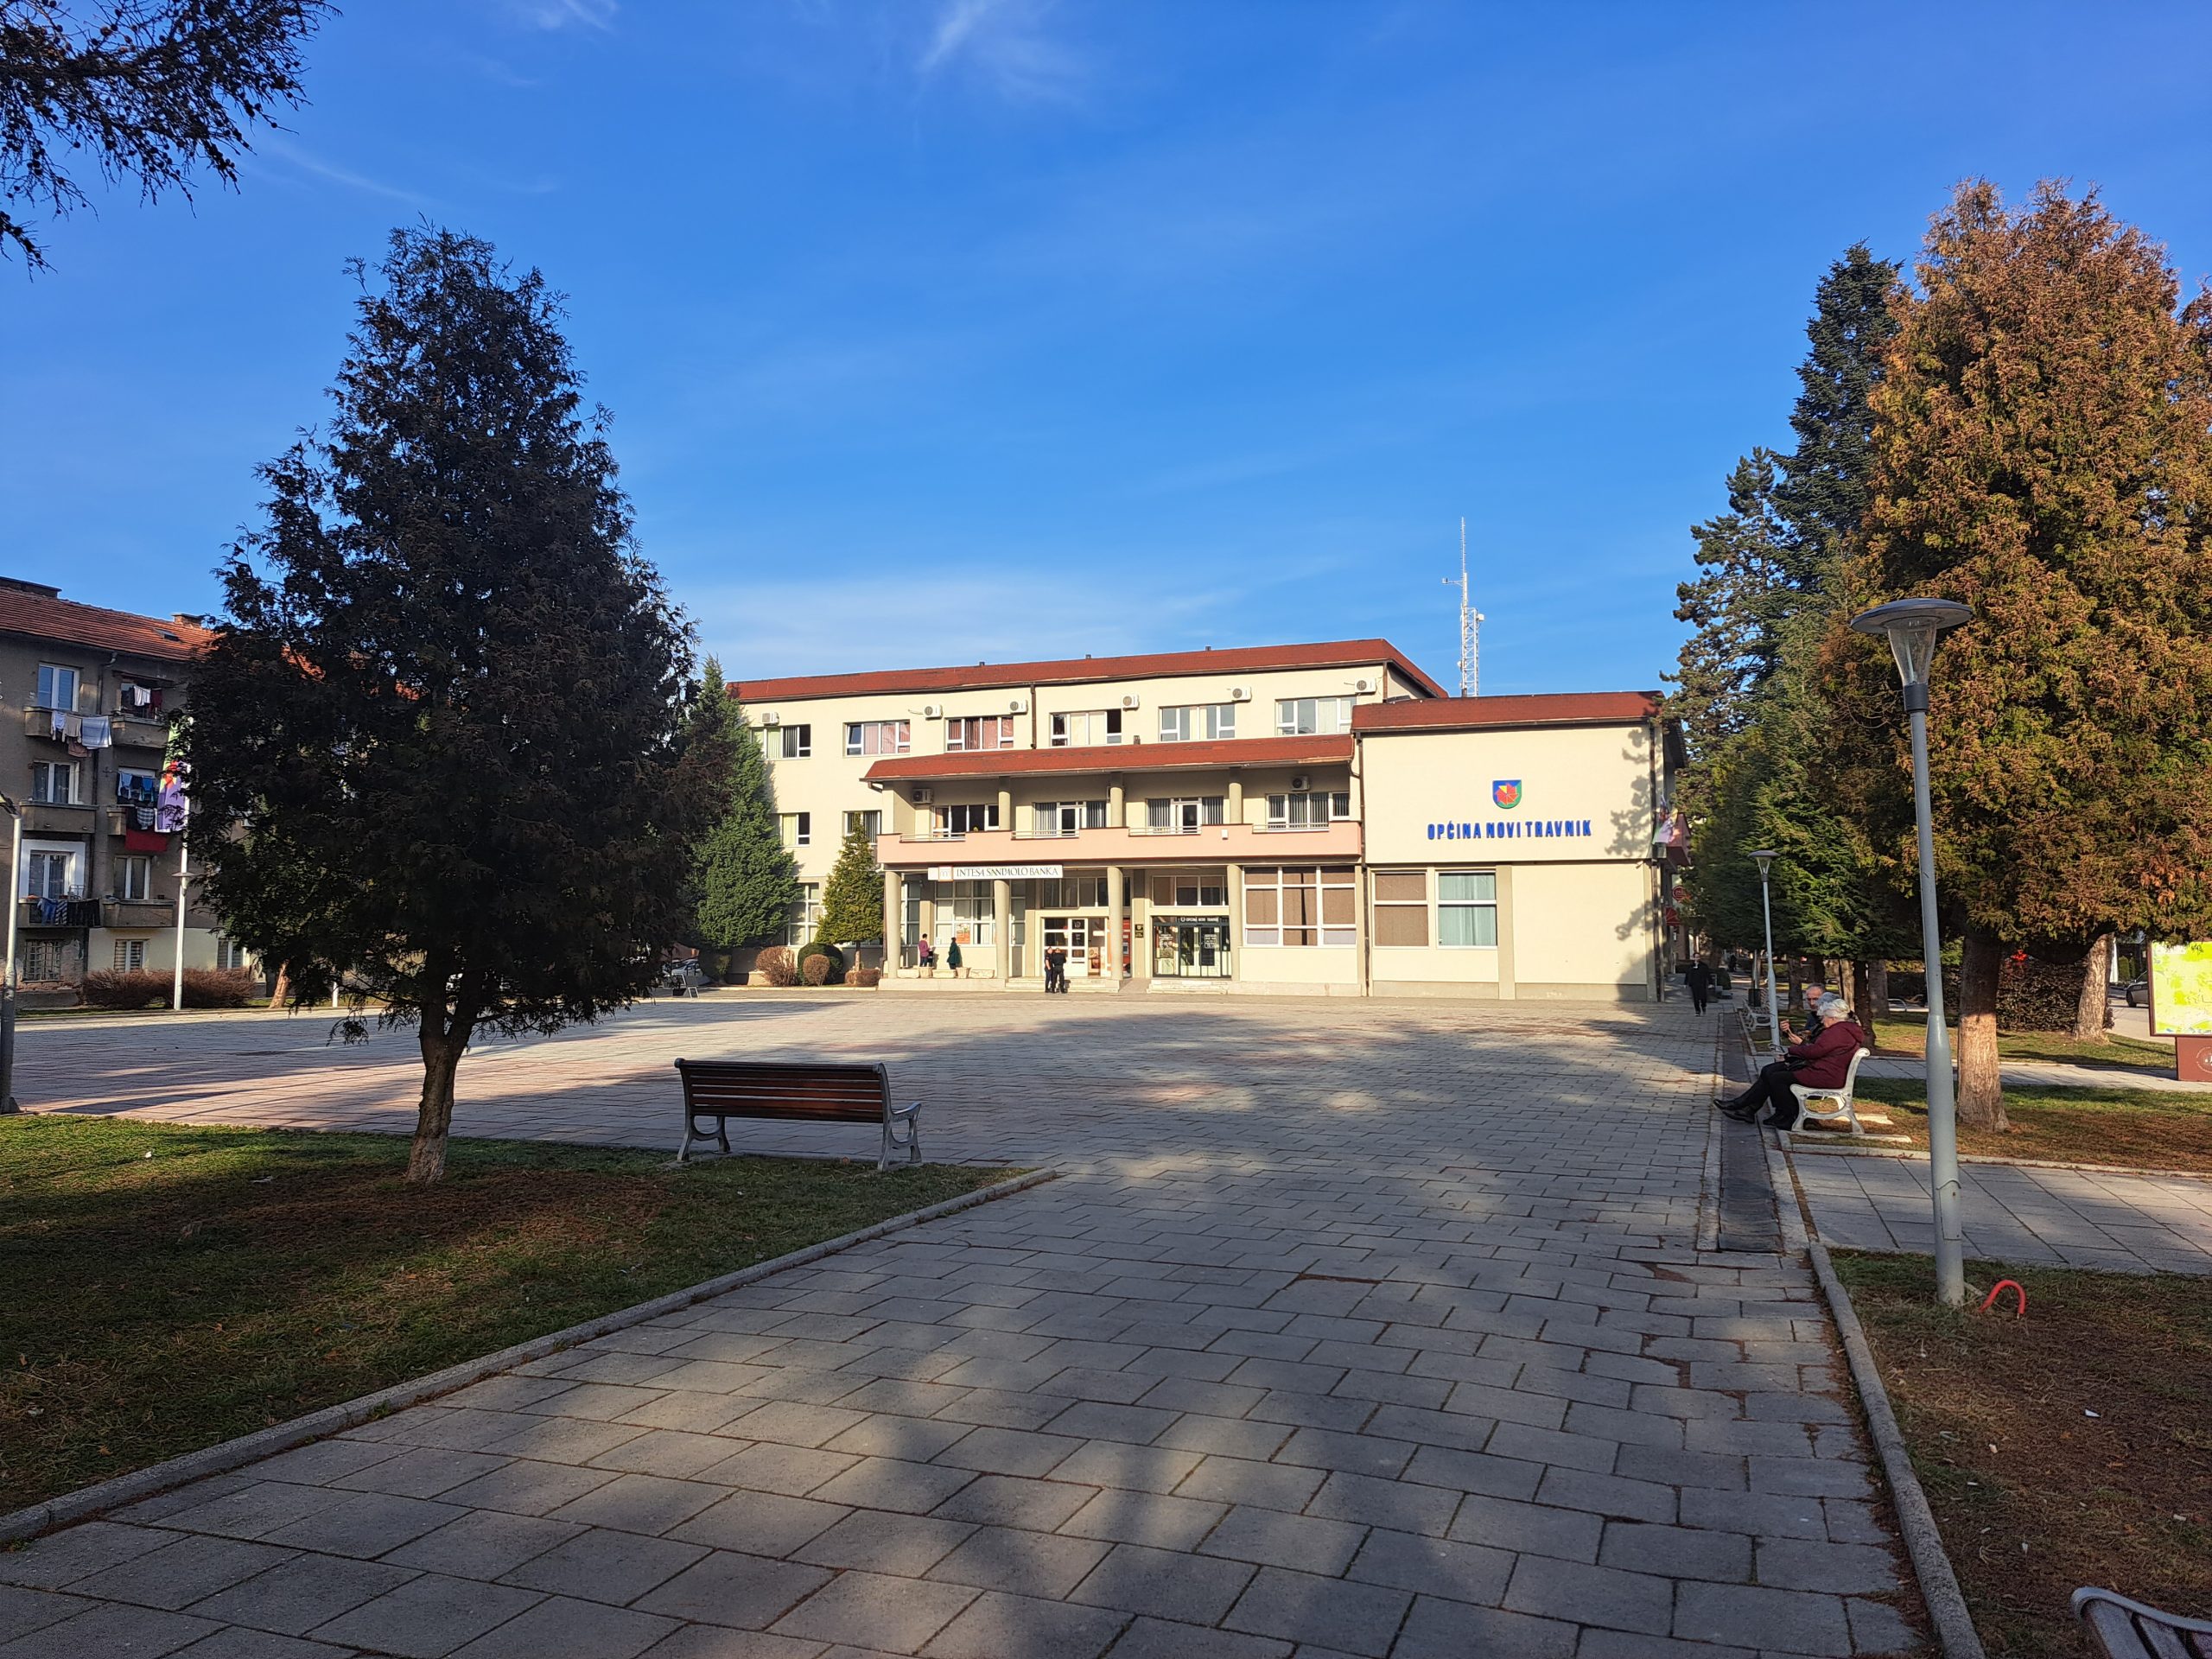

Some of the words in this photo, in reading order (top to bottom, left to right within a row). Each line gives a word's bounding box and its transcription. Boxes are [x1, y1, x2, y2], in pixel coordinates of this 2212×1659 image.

[1427, 820, 1481, 840] OPĆINA
[1485, 822, 1521, 838] NOVI
[1525, 820, 1592, 837] TRAVNIK
[957, 868, 984, 877] INTESA
[986, 868, 1028, 877] SANPAOLO
[1029, 867, 1058, 876] BANKA
